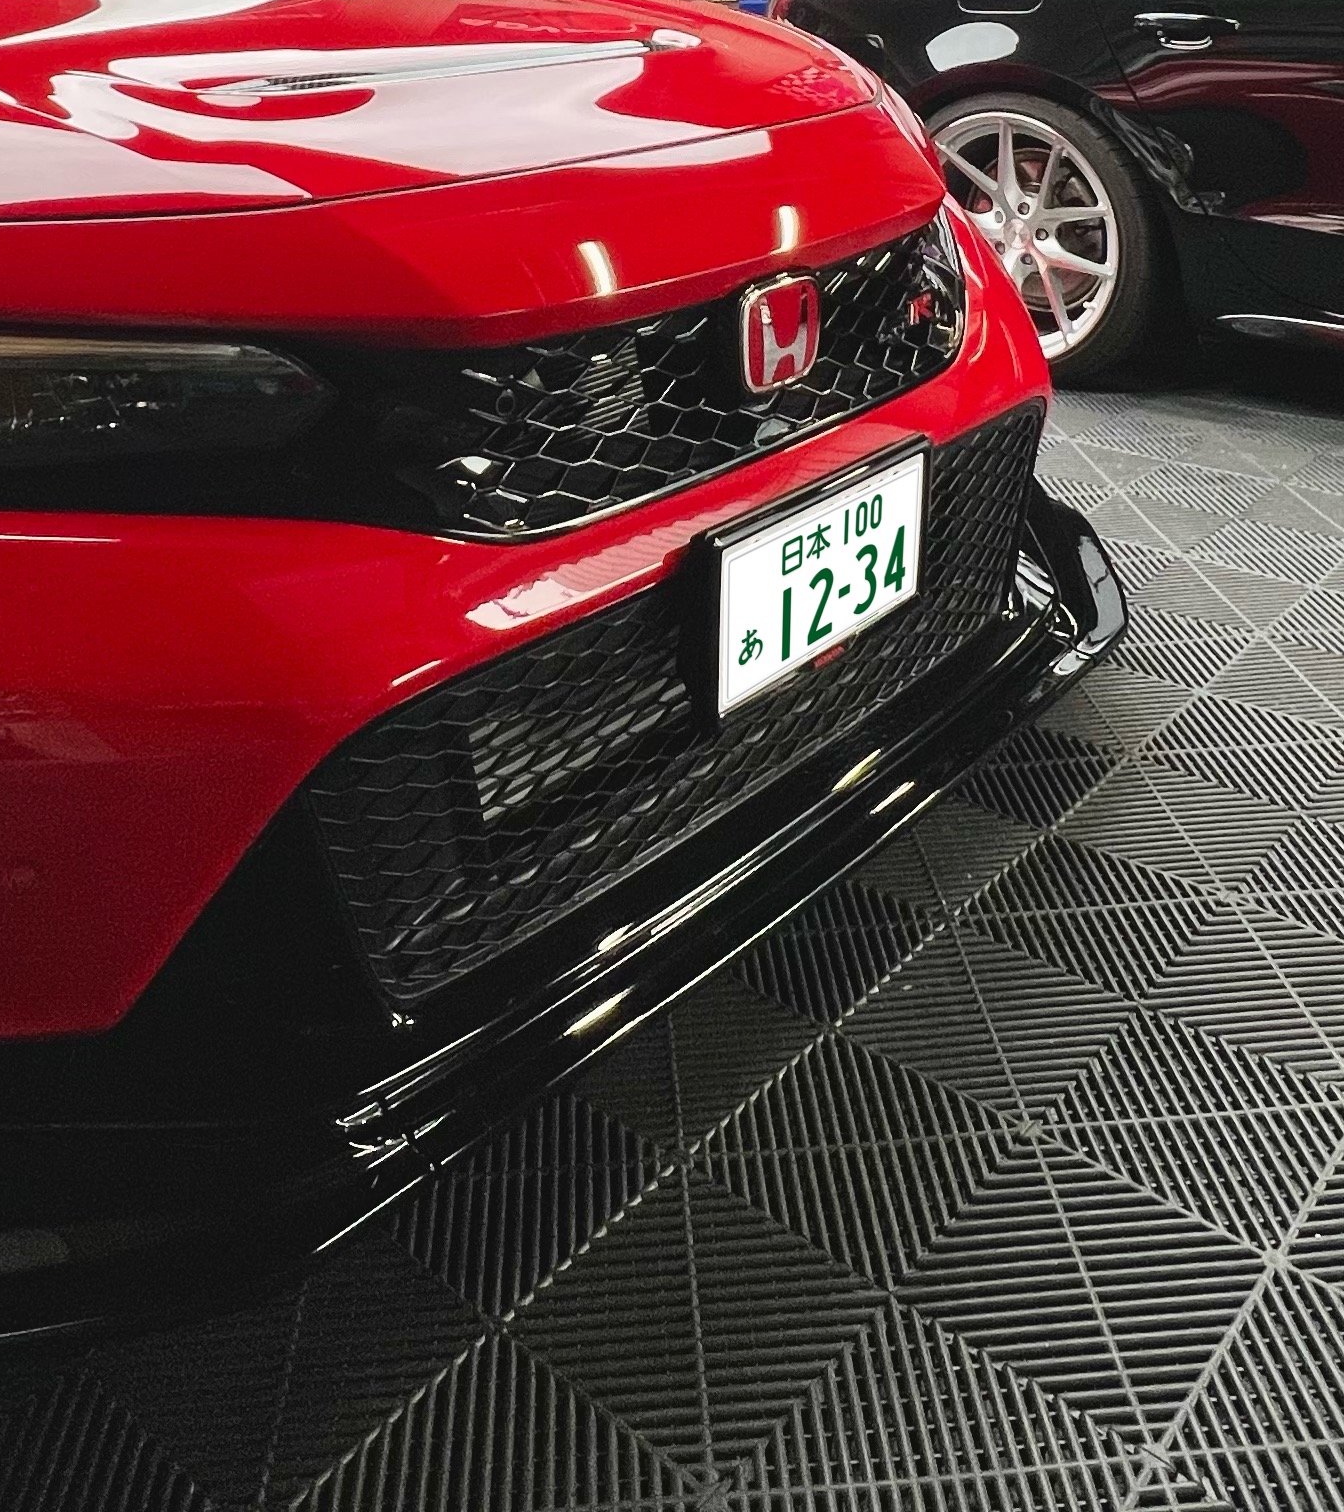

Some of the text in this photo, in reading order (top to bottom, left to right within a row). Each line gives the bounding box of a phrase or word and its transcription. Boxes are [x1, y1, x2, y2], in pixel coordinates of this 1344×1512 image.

[781, 493, 883, 576] 日本 100
[738, 525, 906, 666] あ 12-34
